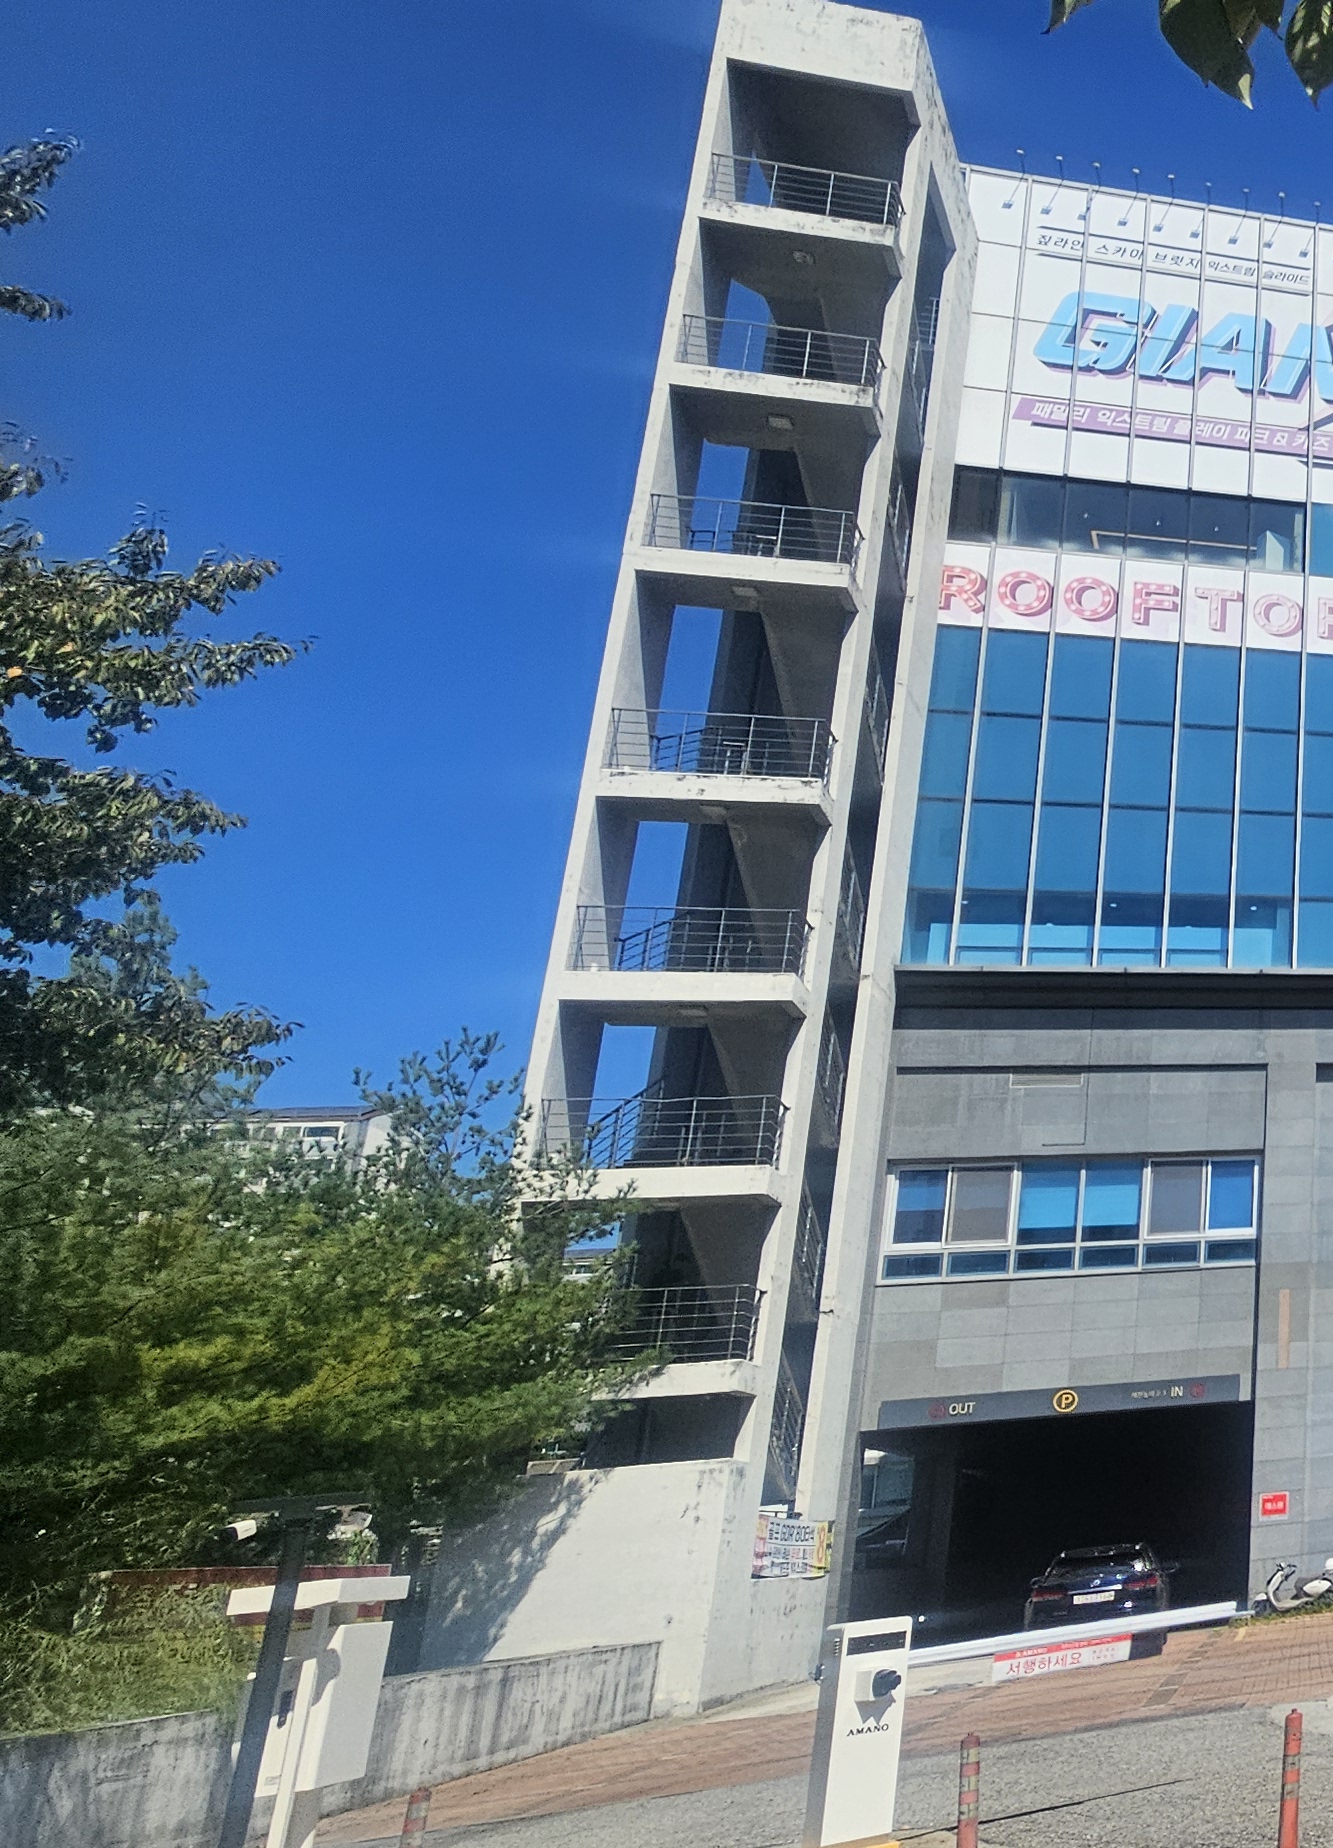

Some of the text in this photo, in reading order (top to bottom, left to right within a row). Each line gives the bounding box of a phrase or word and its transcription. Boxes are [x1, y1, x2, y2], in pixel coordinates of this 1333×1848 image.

[1152, 252, 1201, 270] 브릿지
[1030, 401, 1090, 424] 패밀리
[1097, 409, 1171, 433] 익스트림
[1172, 419, 1231, 440] 플레이
[1234, 427, 1270, 445] 파크
[1273, 432, 1289, 446] &
[1169, 1385, 1184, 1398] IN
[948, 1401, 977, 1416] OUT
[1006, 1652, 1083, 1676] 서행하세요
[846, 1723, 890, 1737] AMANO
